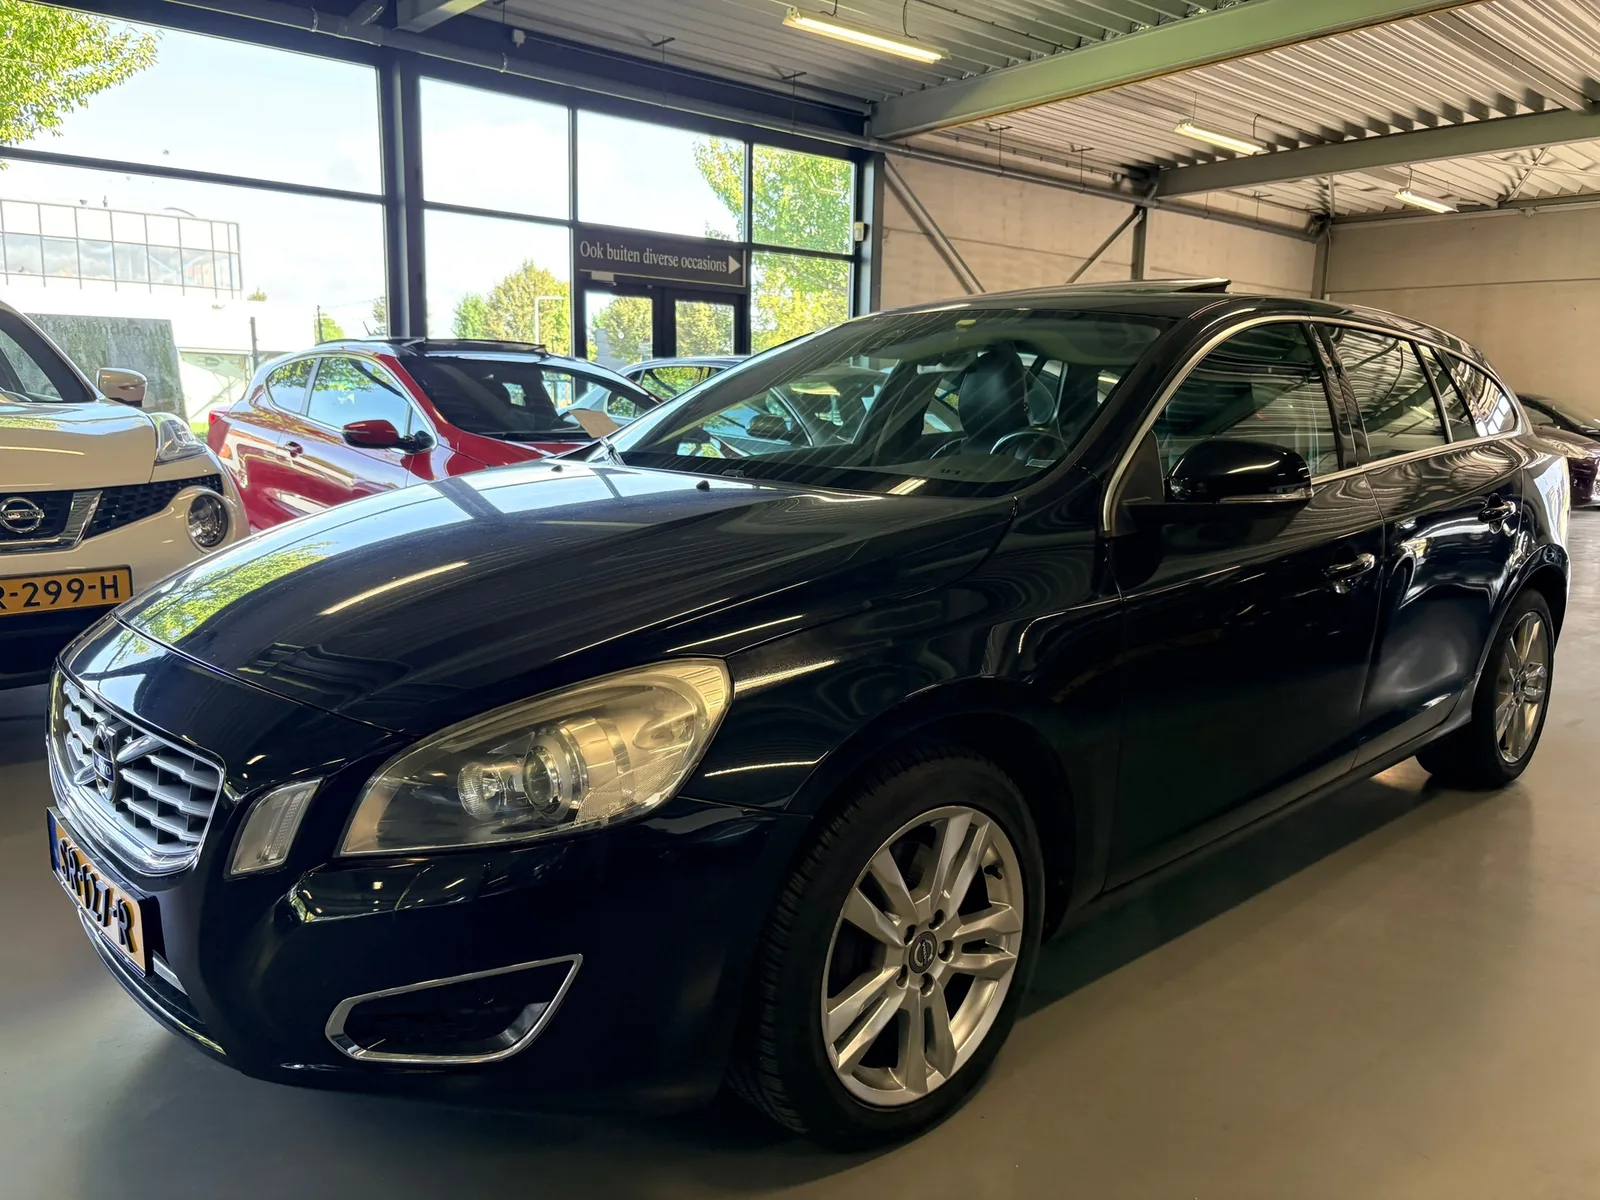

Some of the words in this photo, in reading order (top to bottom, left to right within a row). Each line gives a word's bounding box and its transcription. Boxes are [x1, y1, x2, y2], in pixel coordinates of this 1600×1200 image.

[580, 241, 604, 259] Ook
[606, 243, 641, 263] buiten
[643, 248, 679, 267] diverse
[681, 255, 727, 273] occasions
